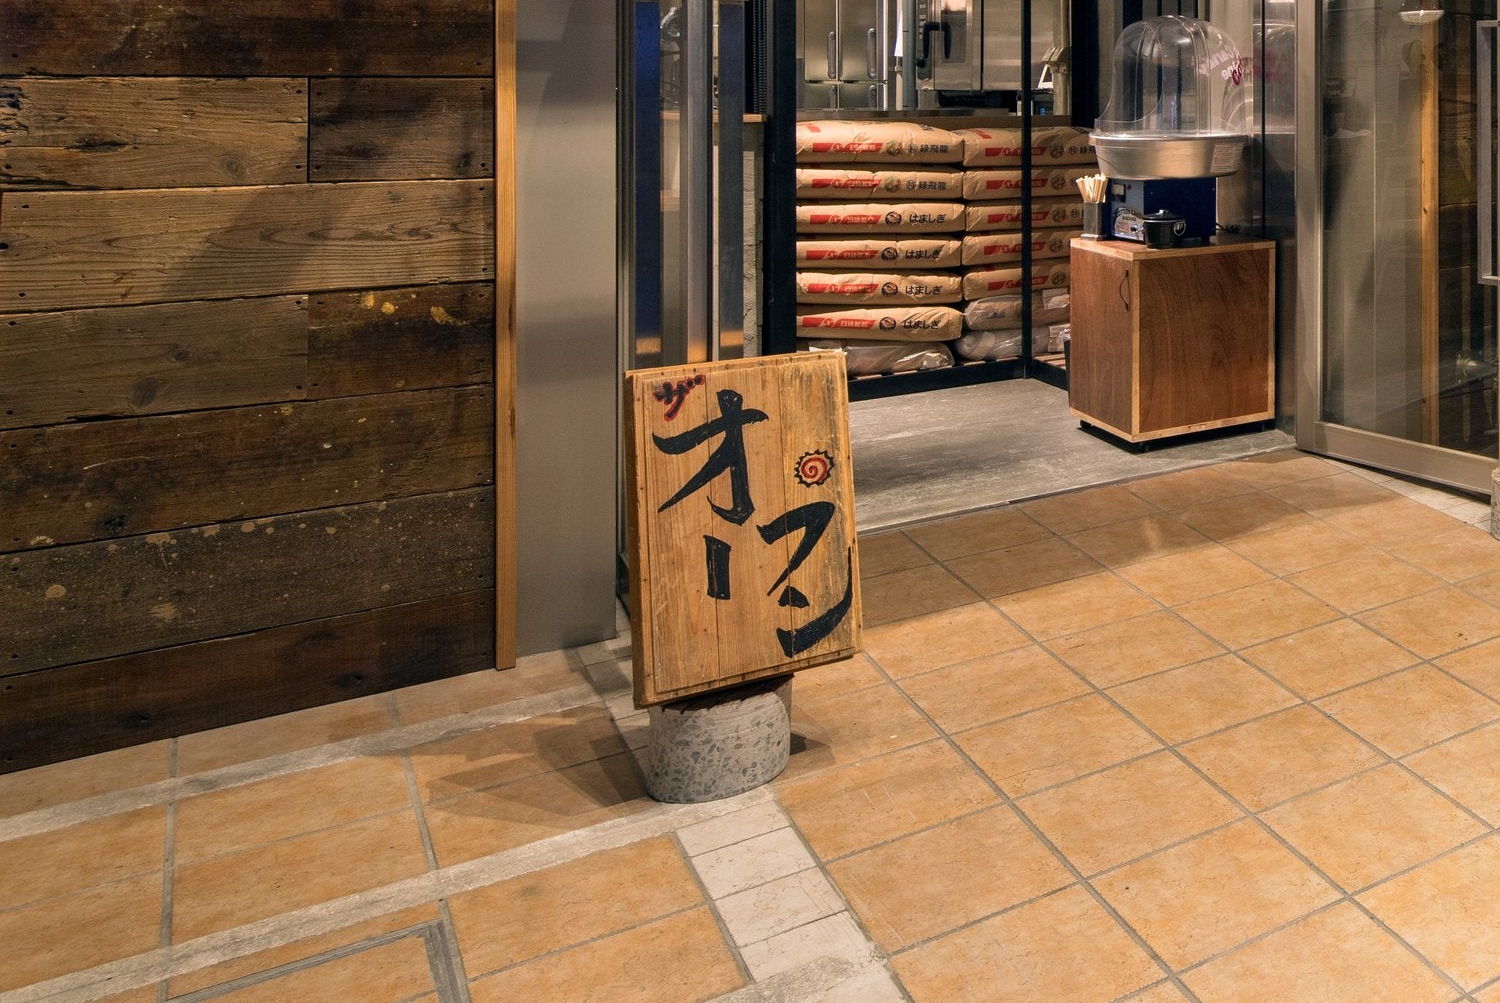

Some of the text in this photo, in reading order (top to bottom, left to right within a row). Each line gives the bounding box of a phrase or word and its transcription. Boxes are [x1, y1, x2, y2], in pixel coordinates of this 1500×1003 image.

[910, 214, 946, 223] はましぎ
[906, 286, 942, 295] はましぎ
[903, 320, 940, 329] はましぎ
